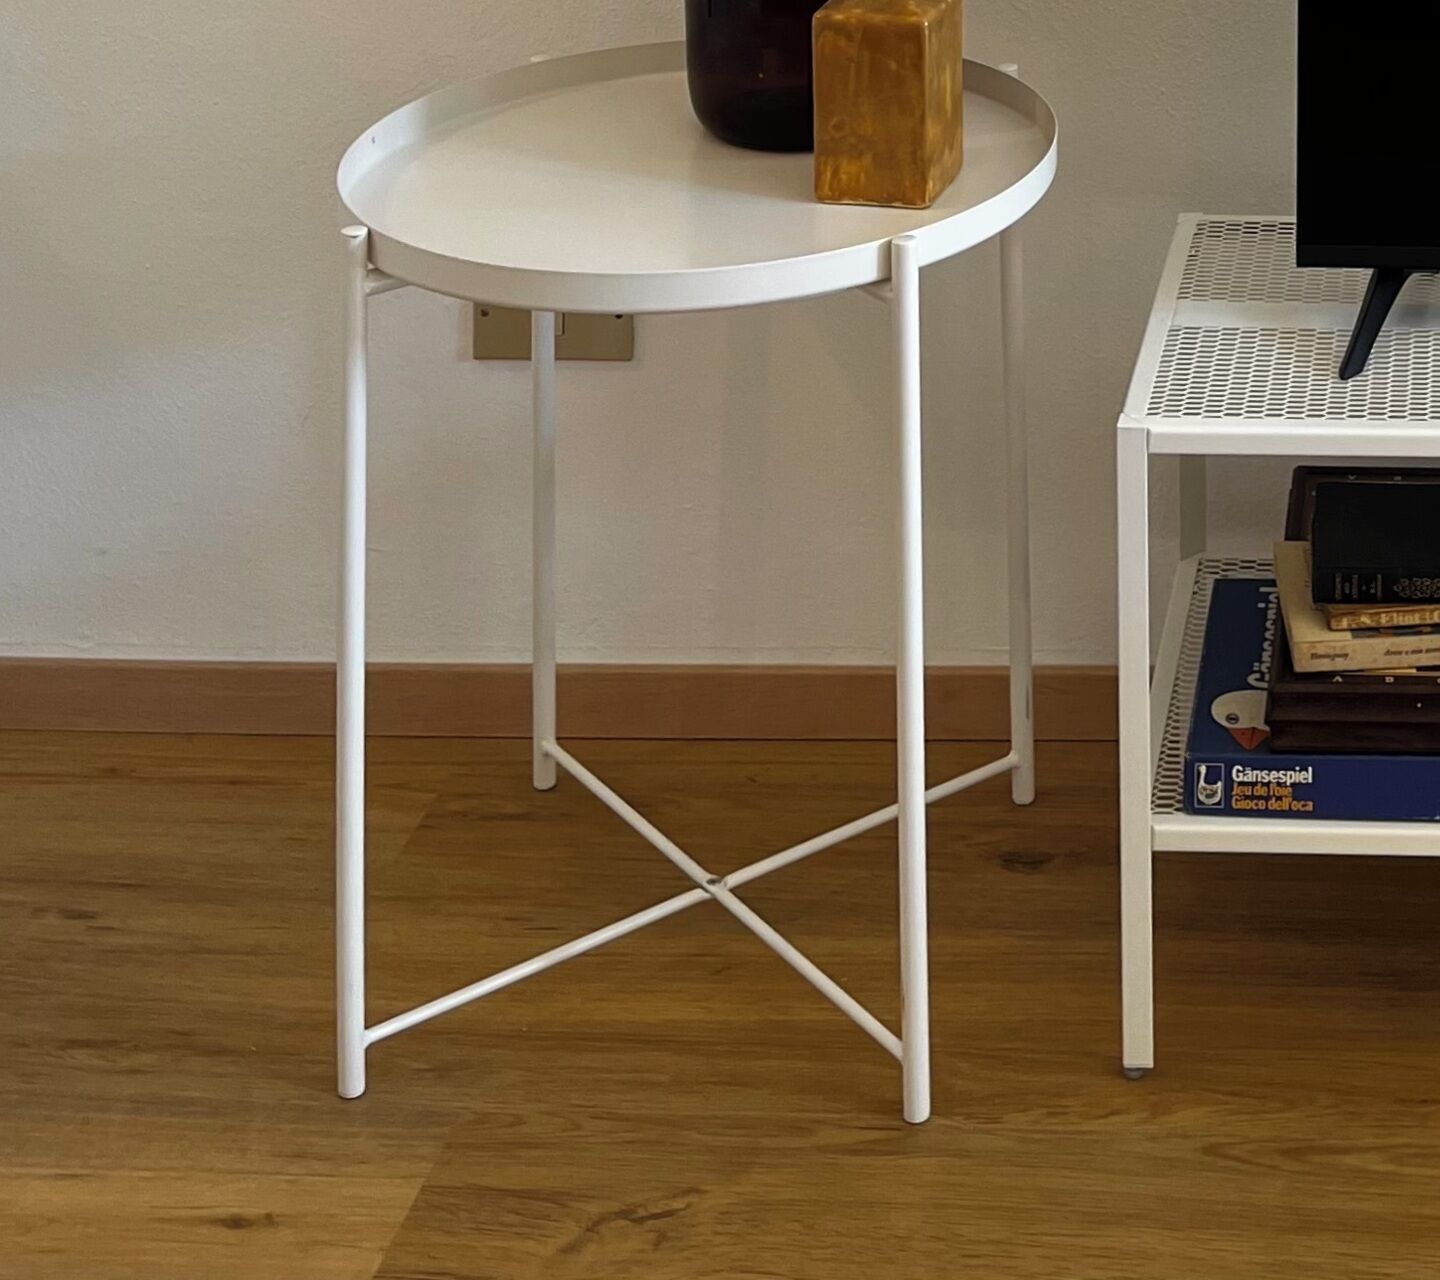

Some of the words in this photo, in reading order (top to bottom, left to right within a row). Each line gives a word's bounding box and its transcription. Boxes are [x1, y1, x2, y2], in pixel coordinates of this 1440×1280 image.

[1231, 765, 1313, 786] Gänsespiel
[1232, 783, 1253, 796] Jeu
[1253, 785, 1268, 796] de
[1231, 796, 1266, 810] Gioco
[1268, 799, 1313, 811] dell'oca
